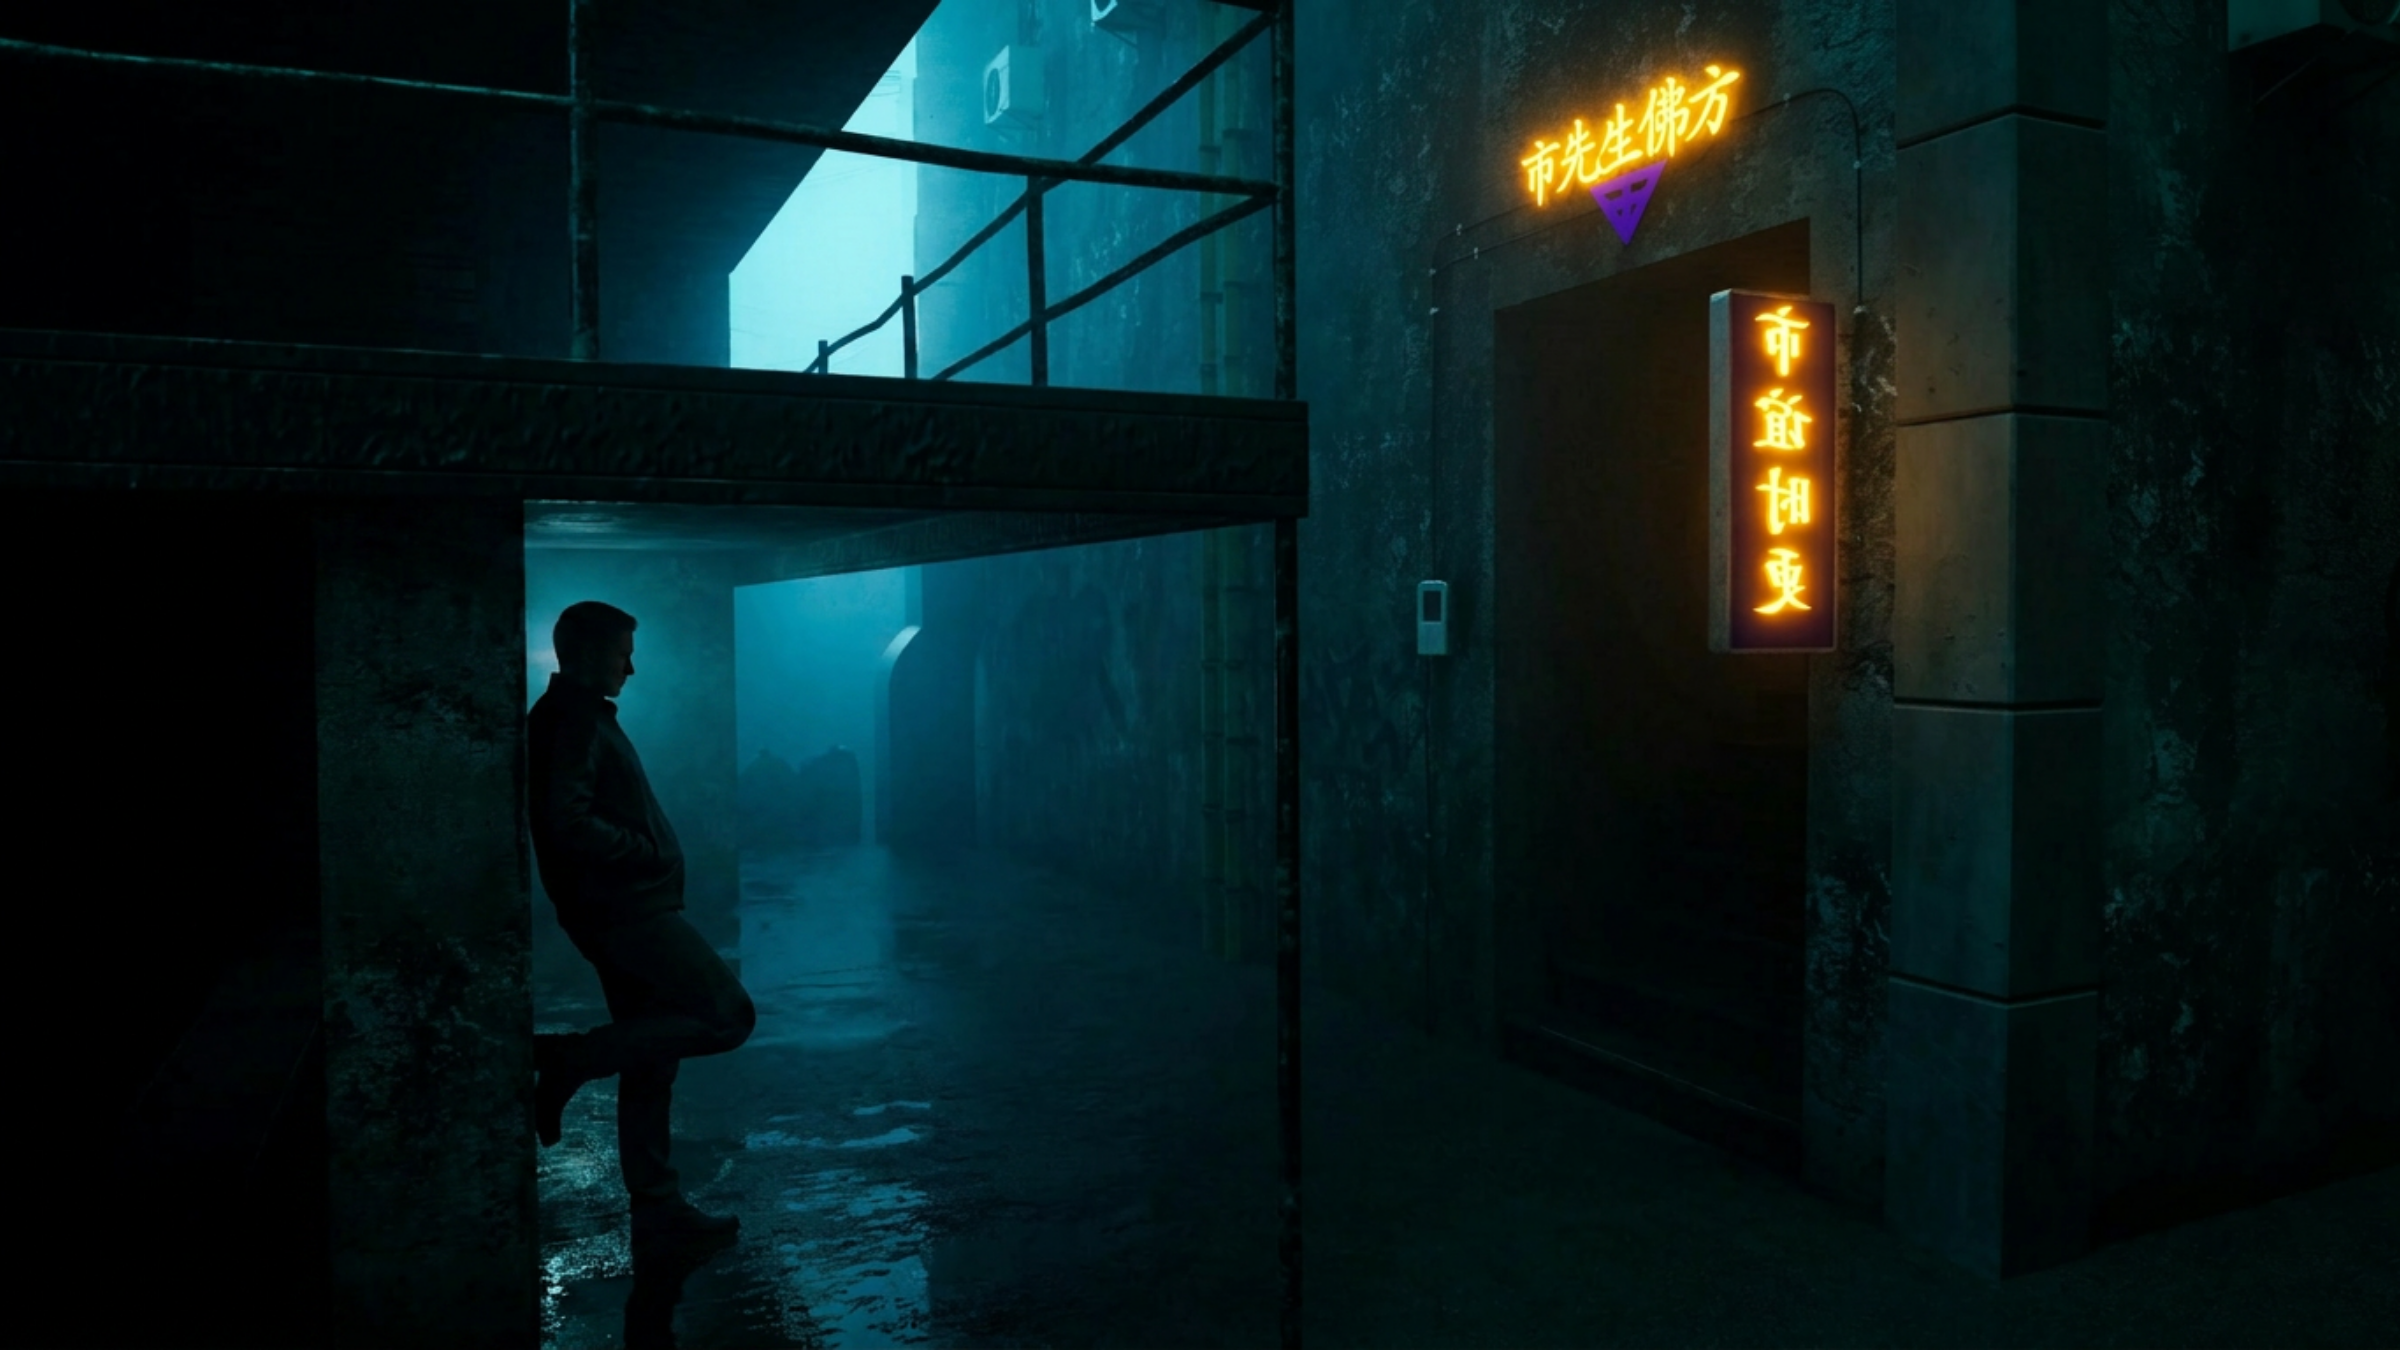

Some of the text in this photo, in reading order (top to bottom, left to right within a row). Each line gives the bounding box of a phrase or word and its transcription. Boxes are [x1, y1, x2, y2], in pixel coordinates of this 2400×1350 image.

[1520, 64, 1741, 207] 市先生佛方
